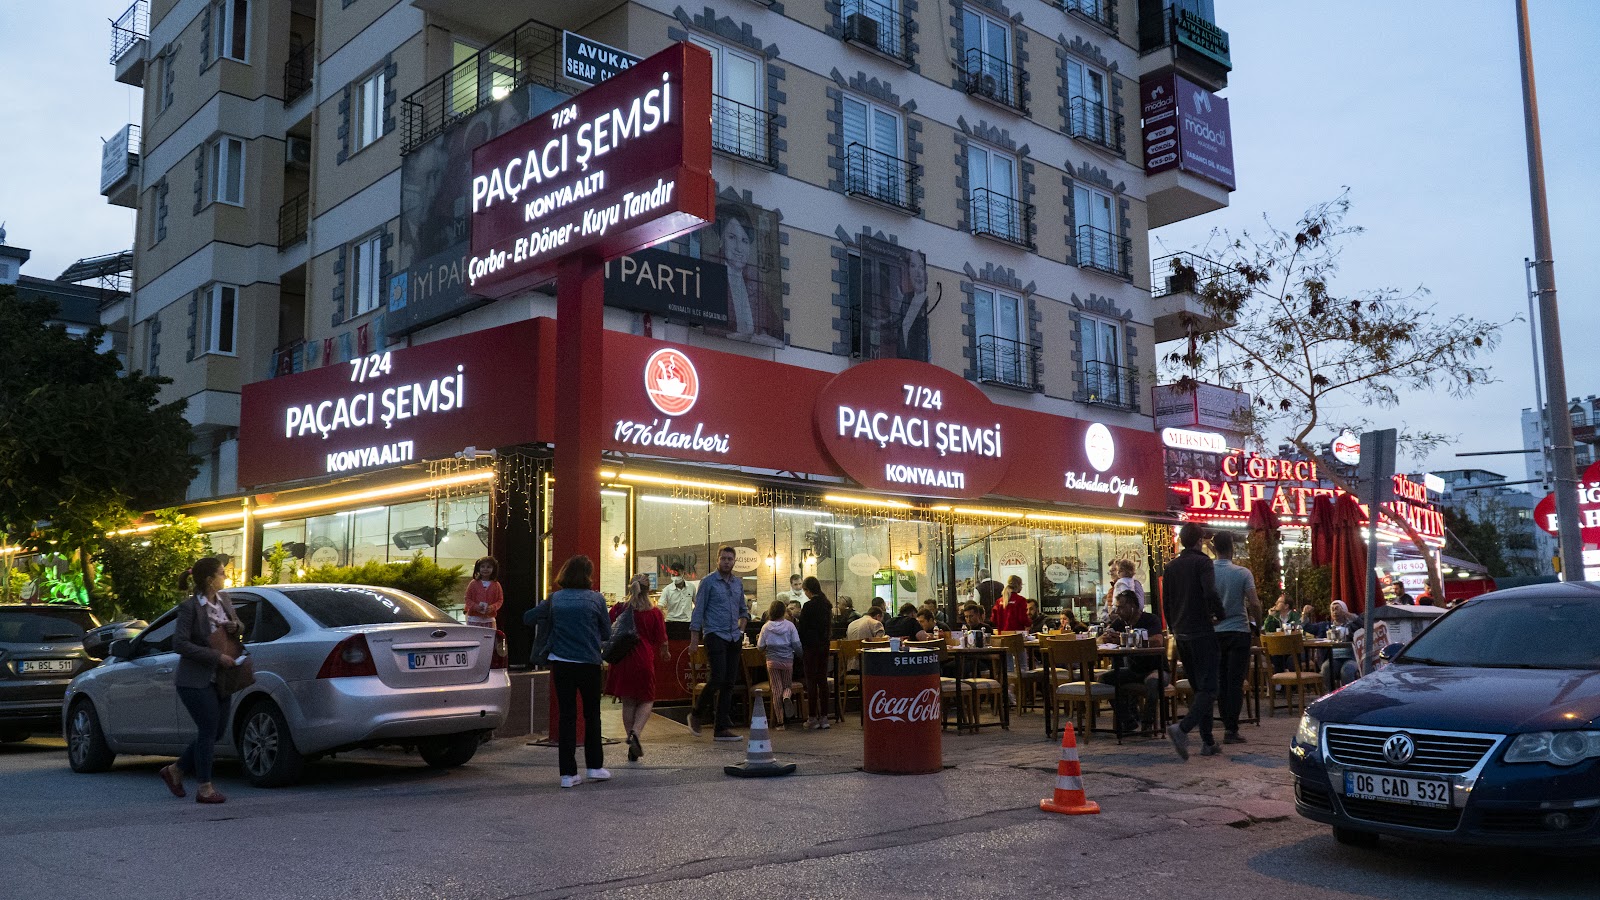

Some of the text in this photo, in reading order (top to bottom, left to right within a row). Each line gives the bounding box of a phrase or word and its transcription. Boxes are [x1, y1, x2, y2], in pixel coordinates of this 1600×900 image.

[566, 57, 596, 80] SERAP
[551, 104, 578, 130] 7/24
[472, 71, 670, 213] PAÇACI ŞEMSİ
[525, 169, 605, 222] KONYAALTI
[468, 248, 505, 286] Çorba
[513, 237, 528, 264] Et
[529, 222, 573, 258] Döner
[581, 203, 619, 236] Kuyu
[622, 178, 675, 220] Tandır
[413, 264, 433, 303] İYİ
[621, 255, 701, 299] PARTİ
[350, 351, 392, 383] 7/24
[285, 364, 464, 440] PAÇACI ŞEMSİ
[903, 384, 942, 411] 7/24
[838, 405, 1002, 457] PAÇACI ŞEMSİ
[326, 440, 414, 473] KONYAALTI
[885, 463, 965, 490] KONYAALTI
[1064, 471, 1110, 493] Babadan
[24, 661, 71, 670] 34 BSL 511
[415, 653, 467, 667] 07 YKF 08
[894, 653, 939, 666] ŞEKERSİZ
[868, 688, 940, 723] Coca-Cola
[1356, 774, 1374, 793] 06
[1381, 777, 1409, 798] CAD
[1417, 781, 1447, 802] 532
